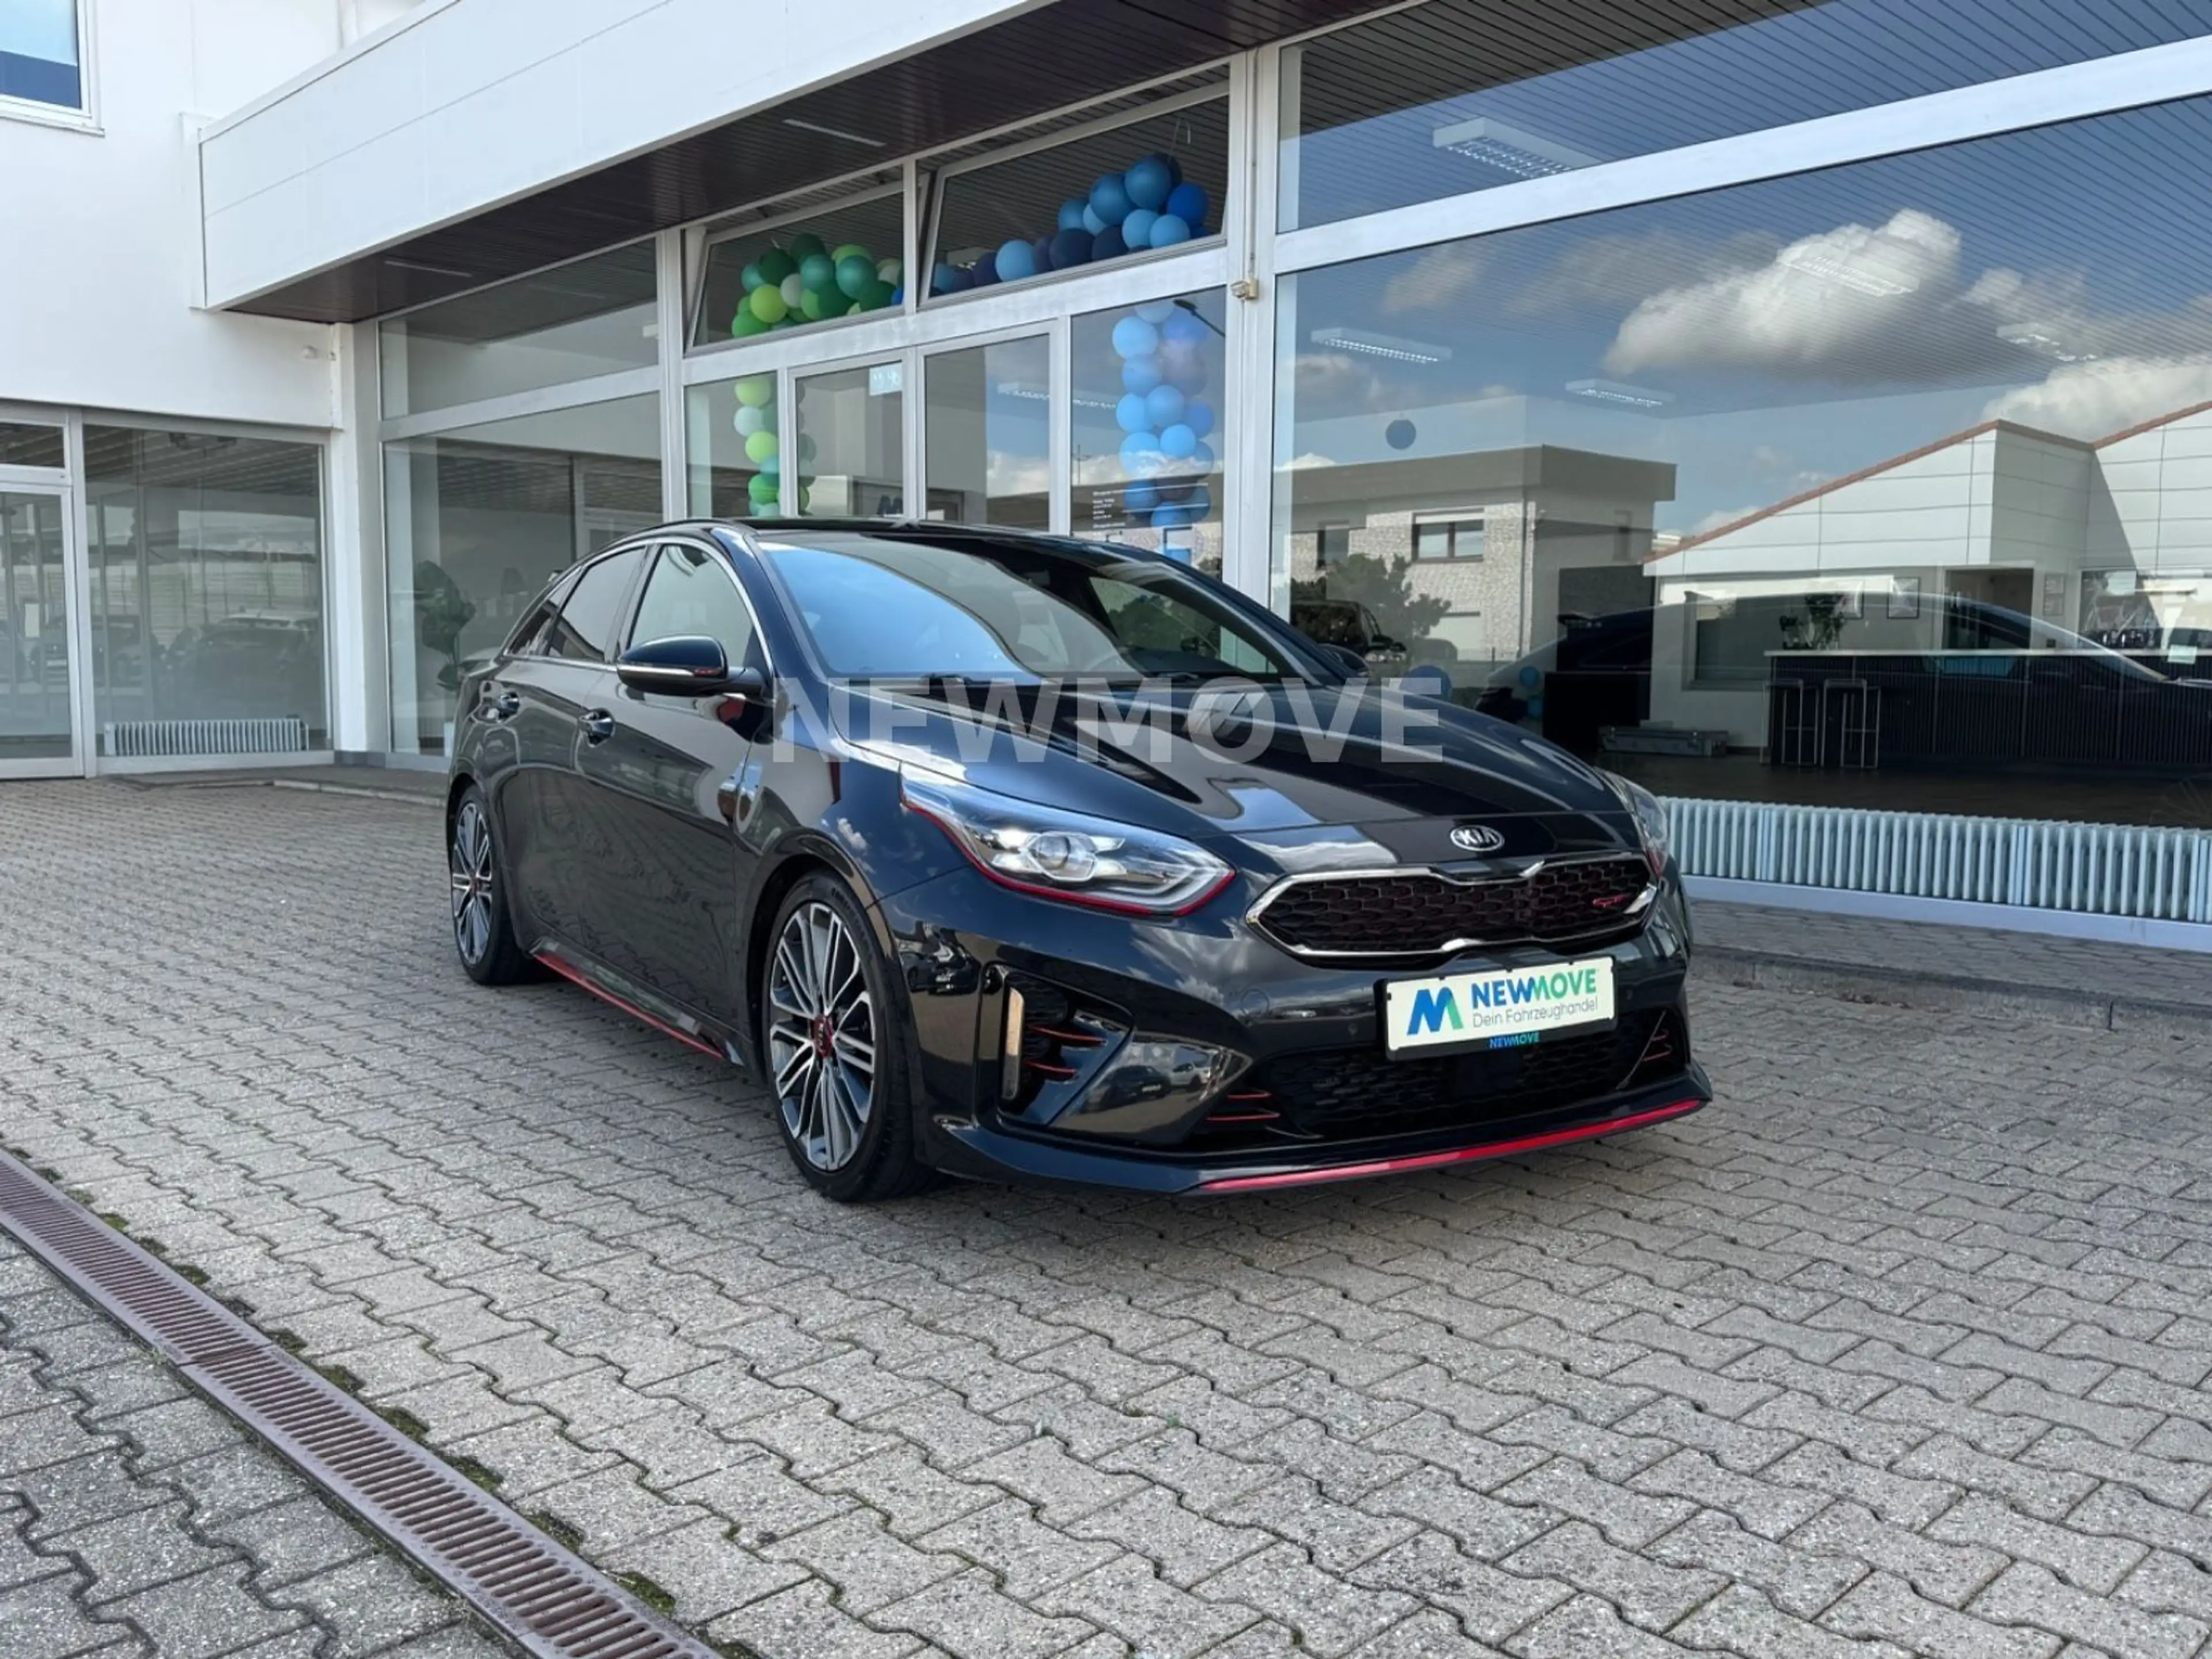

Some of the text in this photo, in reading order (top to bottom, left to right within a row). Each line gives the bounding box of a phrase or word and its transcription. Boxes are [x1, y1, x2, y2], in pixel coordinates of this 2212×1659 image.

[1471, 968, 1597, 1009] NEWMOVE
[1473, 997, 1597, 1028] Dein Fahrzeughandel
[1490, 1032, 1540, 1049] NEWMOVE
